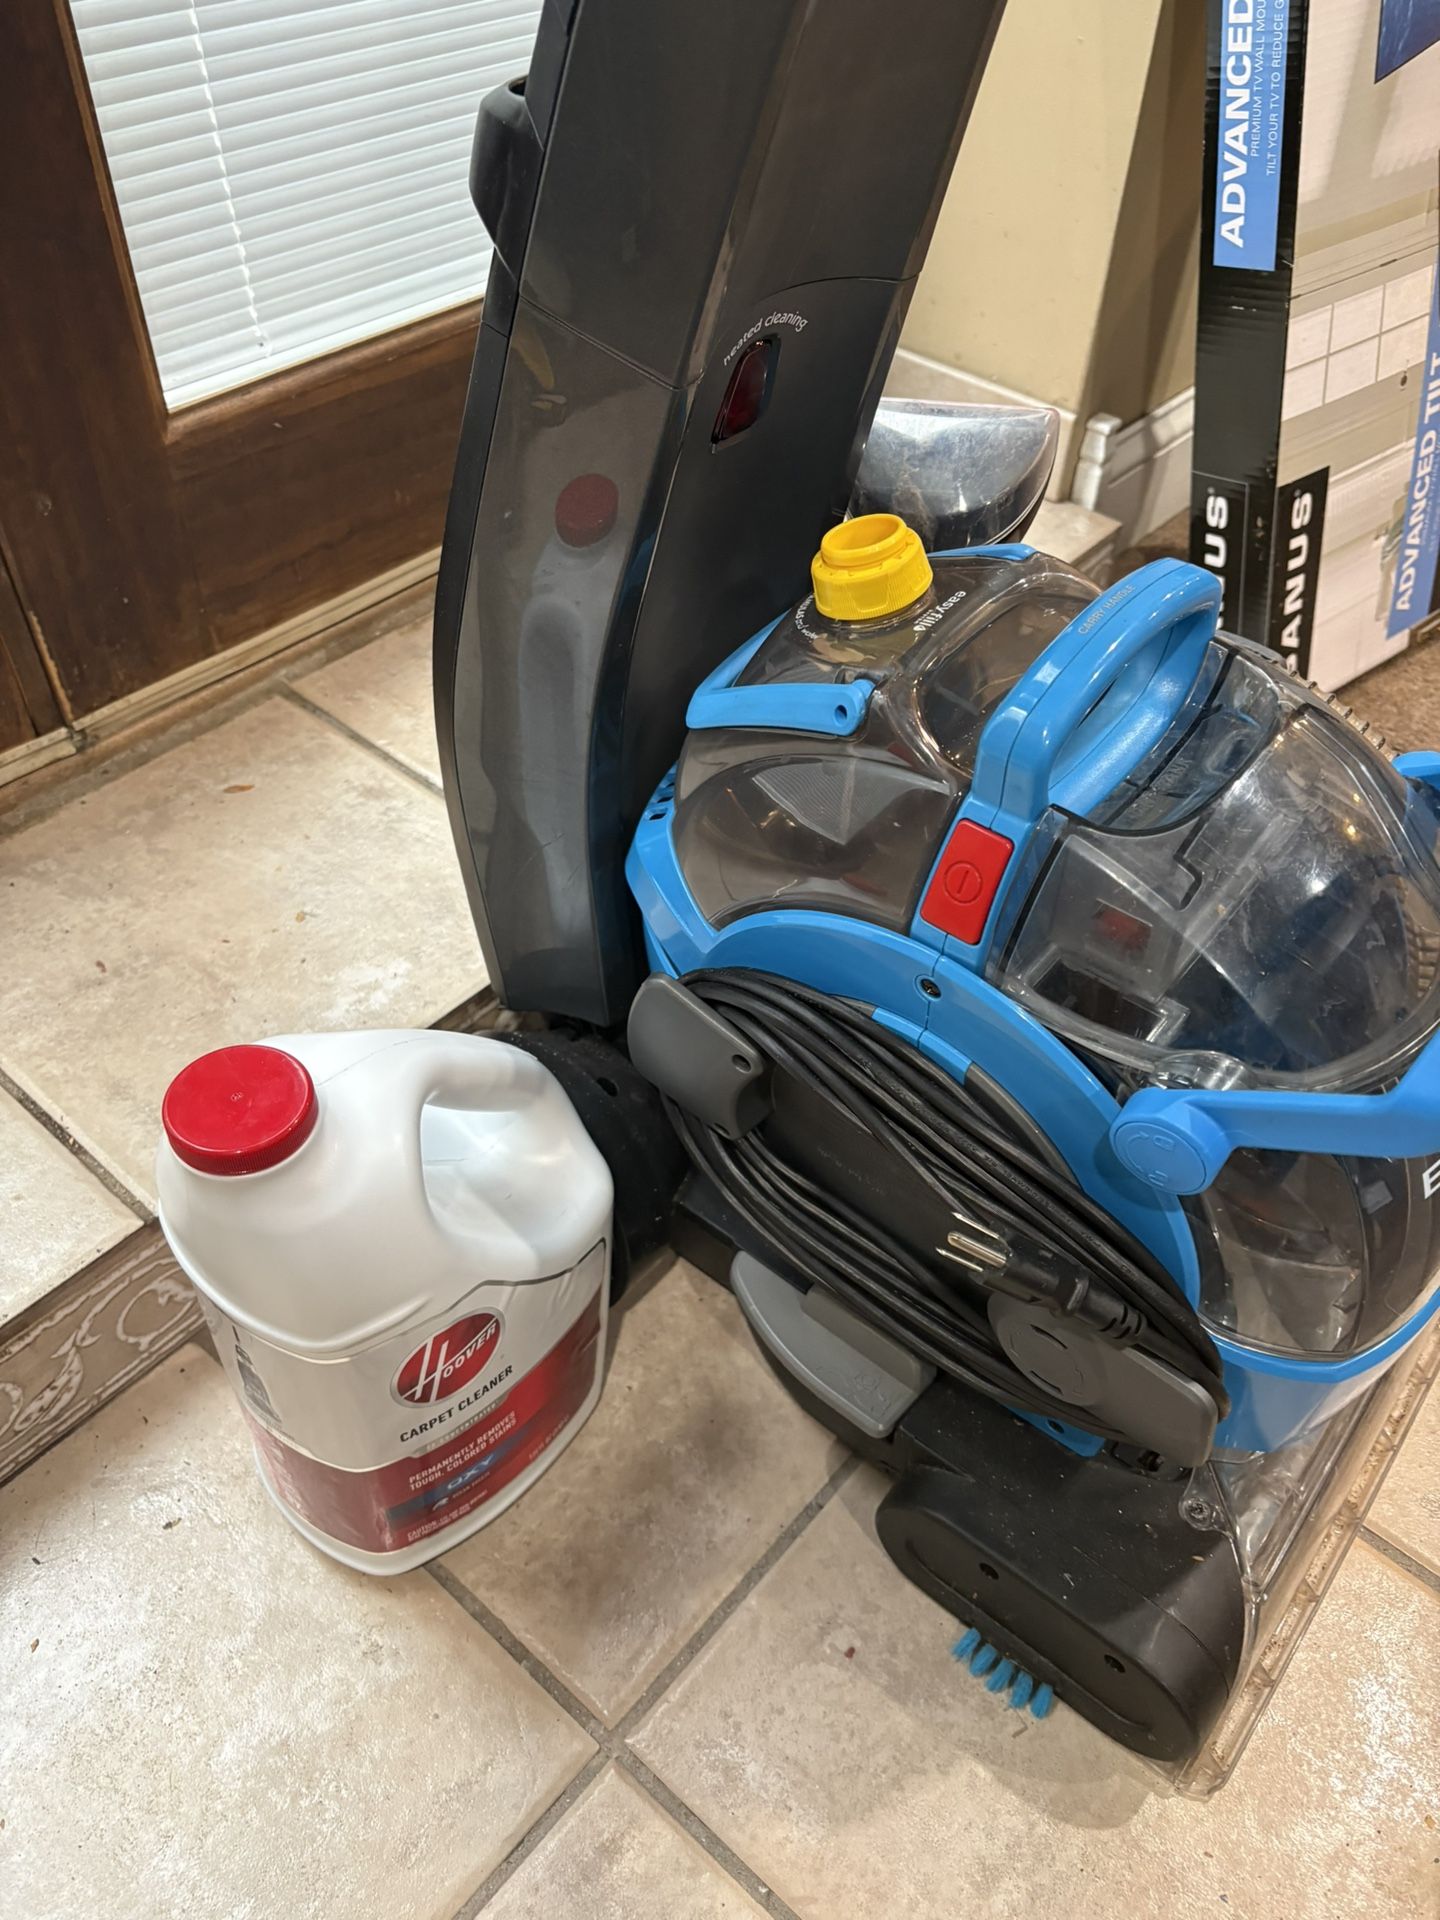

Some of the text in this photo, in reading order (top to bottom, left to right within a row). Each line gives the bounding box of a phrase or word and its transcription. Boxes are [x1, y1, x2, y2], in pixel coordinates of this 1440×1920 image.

[1254, 36, 1266, 73] WALL
[1271, 14, 1284, 68] REDUCE
[1253, 76, 1264, 92] TV
[1269, 91, 1281, 111] TV
[1270, 72, 1282, 90] TO
[1220, 0, 1254, 248] ADVANCED
[1250, 93, 1262, 157] PREMIUM
[1268, 113, 1280, 149] YOUR
[1266, 150, 1278, 176] TILT
[722, 310, 809, 367] heated cleaning
[1396, 429, 1437, 612] ADVANCED
[1078, 584, 1136, 635] CARRY HANDLE
[401, 1316, 499, 1403] HOOVER
[400, 1364, 514, 1443] CARPET CLEANER
[408, 1442, 475, 1484] PERMANENTLY
[477, 1410, 516, 1444] REMOVES
[446, 1442, 487, 1472] COLORED
[488, 1417, 517, 1446] STAINS
[447, 1453, 495, 1490] OXY
